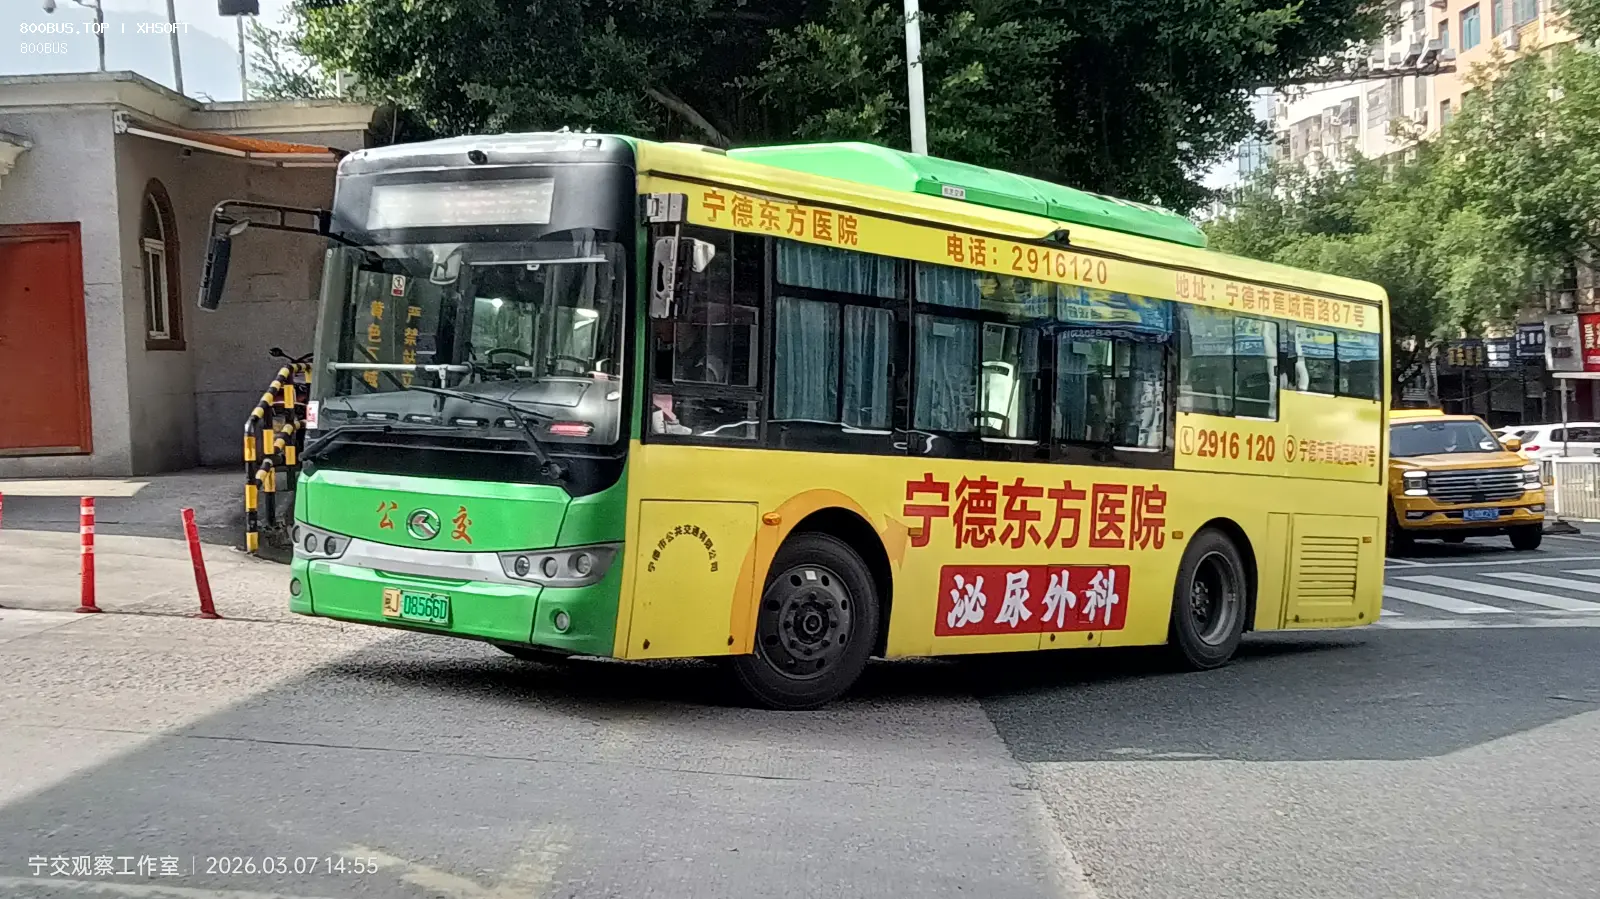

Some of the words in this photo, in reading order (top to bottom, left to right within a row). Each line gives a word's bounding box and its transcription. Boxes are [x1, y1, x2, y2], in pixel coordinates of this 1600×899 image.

[702, 188, 859, 247] 宁德东方医院
[902, 472, 1168, 551] 宁德东方医院
[946, 567, 1120, 629] 泌尿外科
